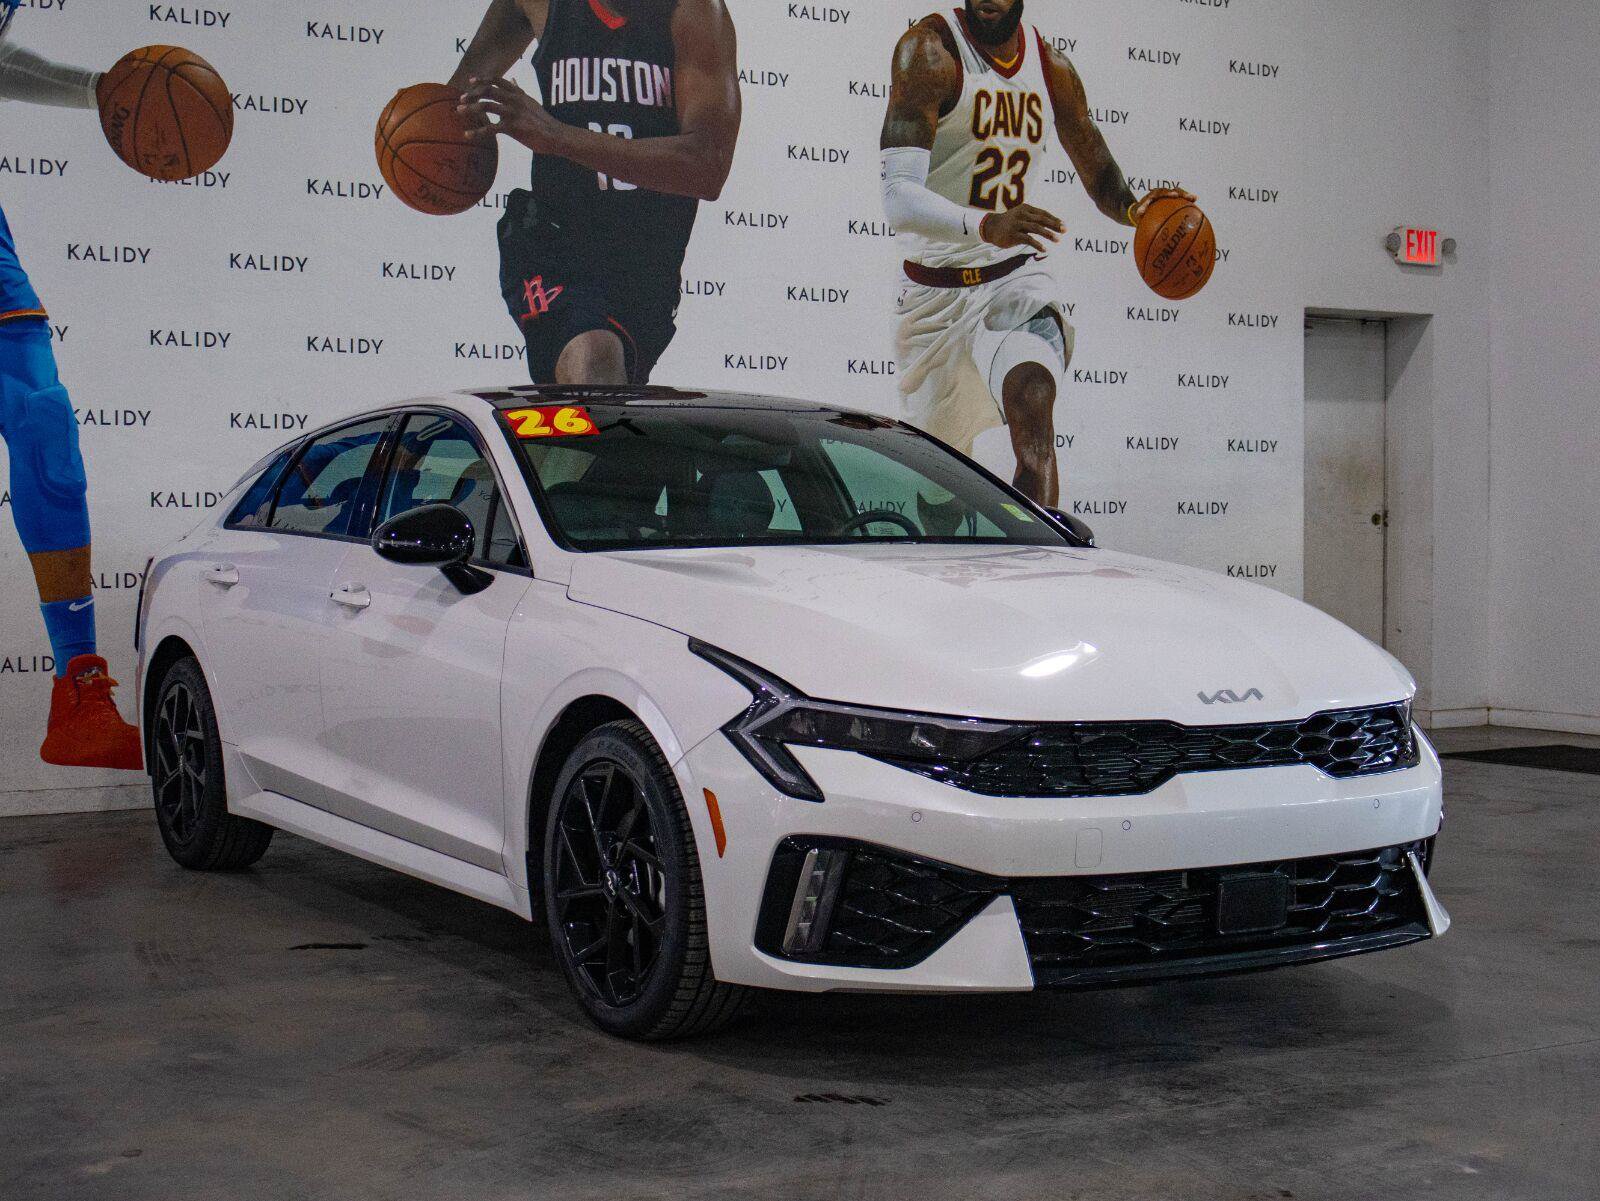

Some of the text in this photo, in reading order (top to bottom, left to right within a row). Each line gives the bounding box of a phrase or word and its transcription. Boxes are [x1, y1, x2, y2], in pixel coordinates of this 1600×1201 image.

[150, 5, 230, 27] KALIDY
[789, 4, 850, 23] KALIDY
[307, 22, 384, 44] KALIDY
[1129, 47, 1180, 65] KALIDY
[1230, 60, 1278, 78] KALIDY
[552, 57, 672, 106] HOUSTON
[231, 94, 308, 115] KALIDY
[972, 89, 1042, 144] CAVS
[1180, 118, 1230, 135] KALIDY
[788, 145, 849, 163] KALIDY
[969, 147, 1031, 212] 23
[308, 179, 383, 199] KALIDY
[1229, 186, 1278, 203] KALIDY
[726, 211, 788, 228] KALIDY
[68, 244, 150, 263] KALIDY
[1075, 238, 1128, 254] KALIDY
[1406, 229, 1437, 264] EXIT
[230, 253, 307, 272] KALIDY
[383, 262, 455, 281] KALIDY
[962, 268, 982, 285] CLE
[788, 287, 848, 303] KALIDY
[1127, 307, 1179, 322] KALIDY
[1229, 313, 1278, 328] KALIDY
[151, 330, 231, 348] KALIDY
[308, 336, 383, 354] KALIDY
[456, 343, 526, 360] KALIDY
[725, 354, 788, 370] KALIDY
[1074, 370, 1127, 384] KALIDY
[1178, 374, 1229, 388] KALIDY
[231, 413, 308, 429] KALIDY
[508, 407, 593, 436] 26
[1127, 437, 1178, 450] KALIDY
[1228, 439, 1277, 452] KALIDY
[151, 492, 223, 507] KALID
[1074, 501, 1127, 514] KALIDY
[1178, 502, 1228, 514] KALIDY
[1228, 565, 1276, 577] KALIDY
